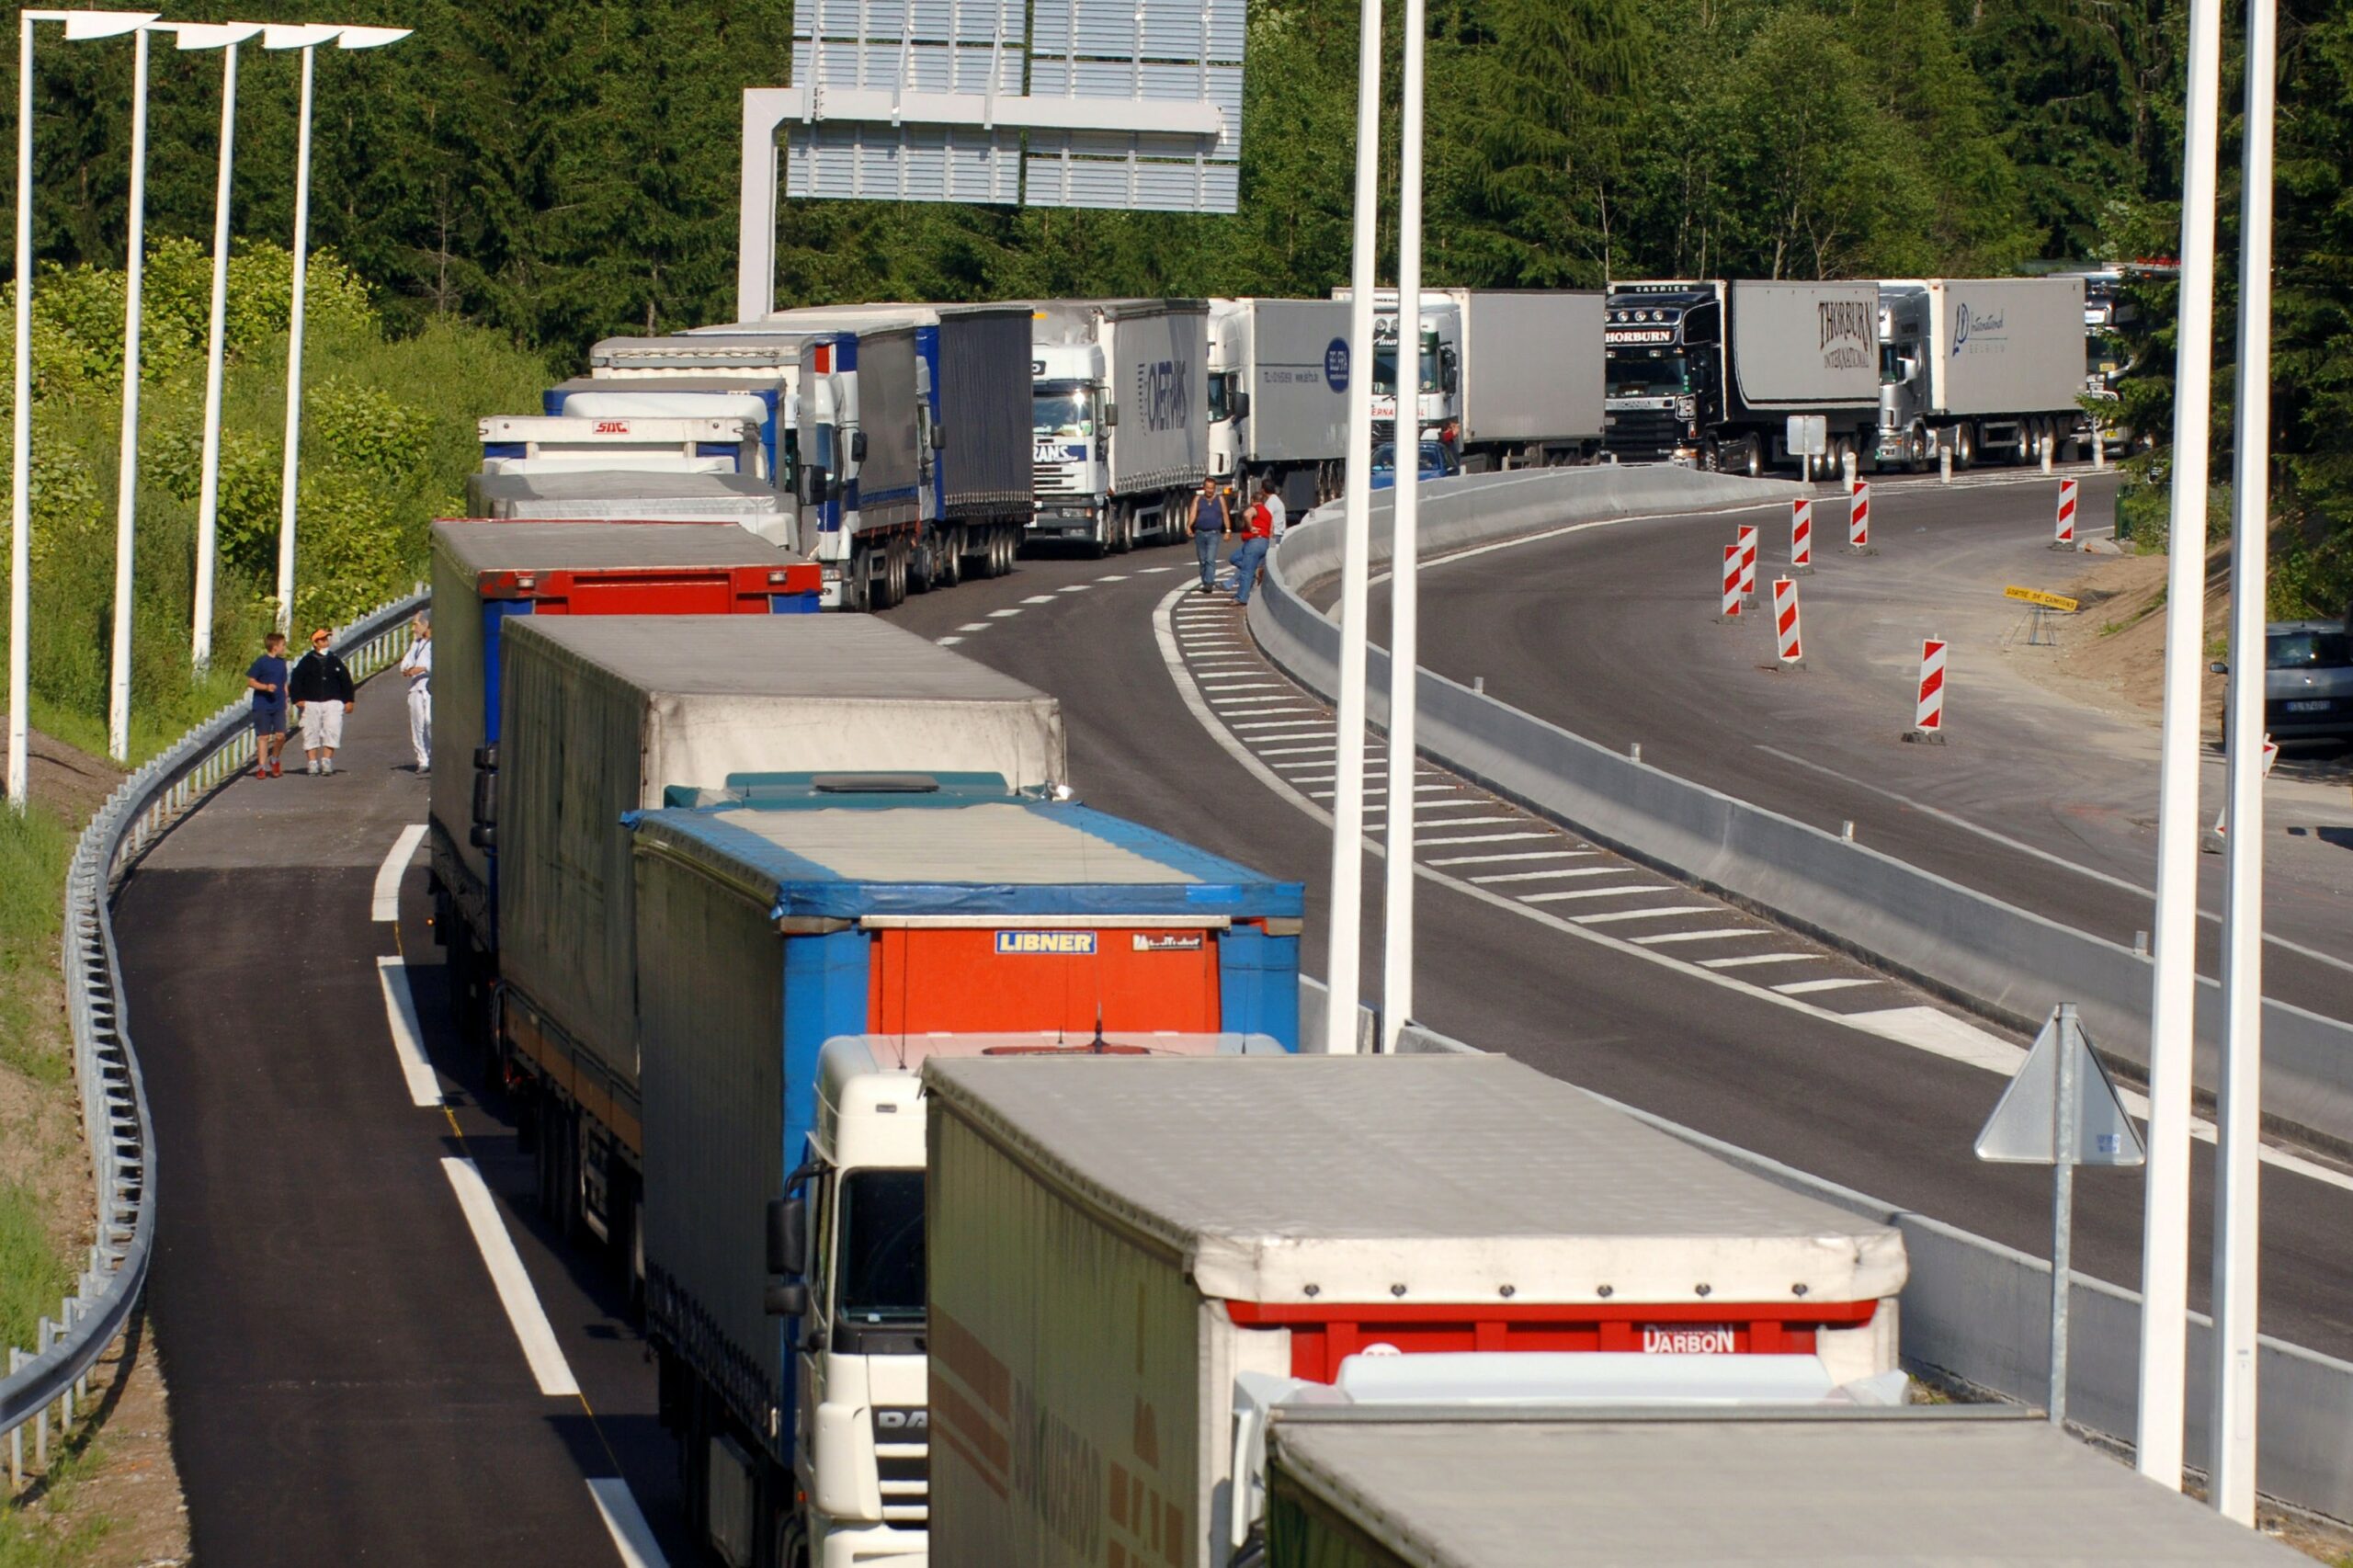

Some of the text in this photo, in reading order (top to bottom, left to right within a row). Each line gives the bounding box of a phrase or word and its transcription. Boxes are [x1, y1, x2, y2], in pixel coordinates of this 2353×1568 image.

[1605, 331, 1670, 343] HORBURN
[1818, 301, 1873, 357] THORBURN
[999, 933, 1092, 951] LIBNER
[1643, 1324, 1735, 1354] DARBON
[879, 1411, 927, 1427] DA
